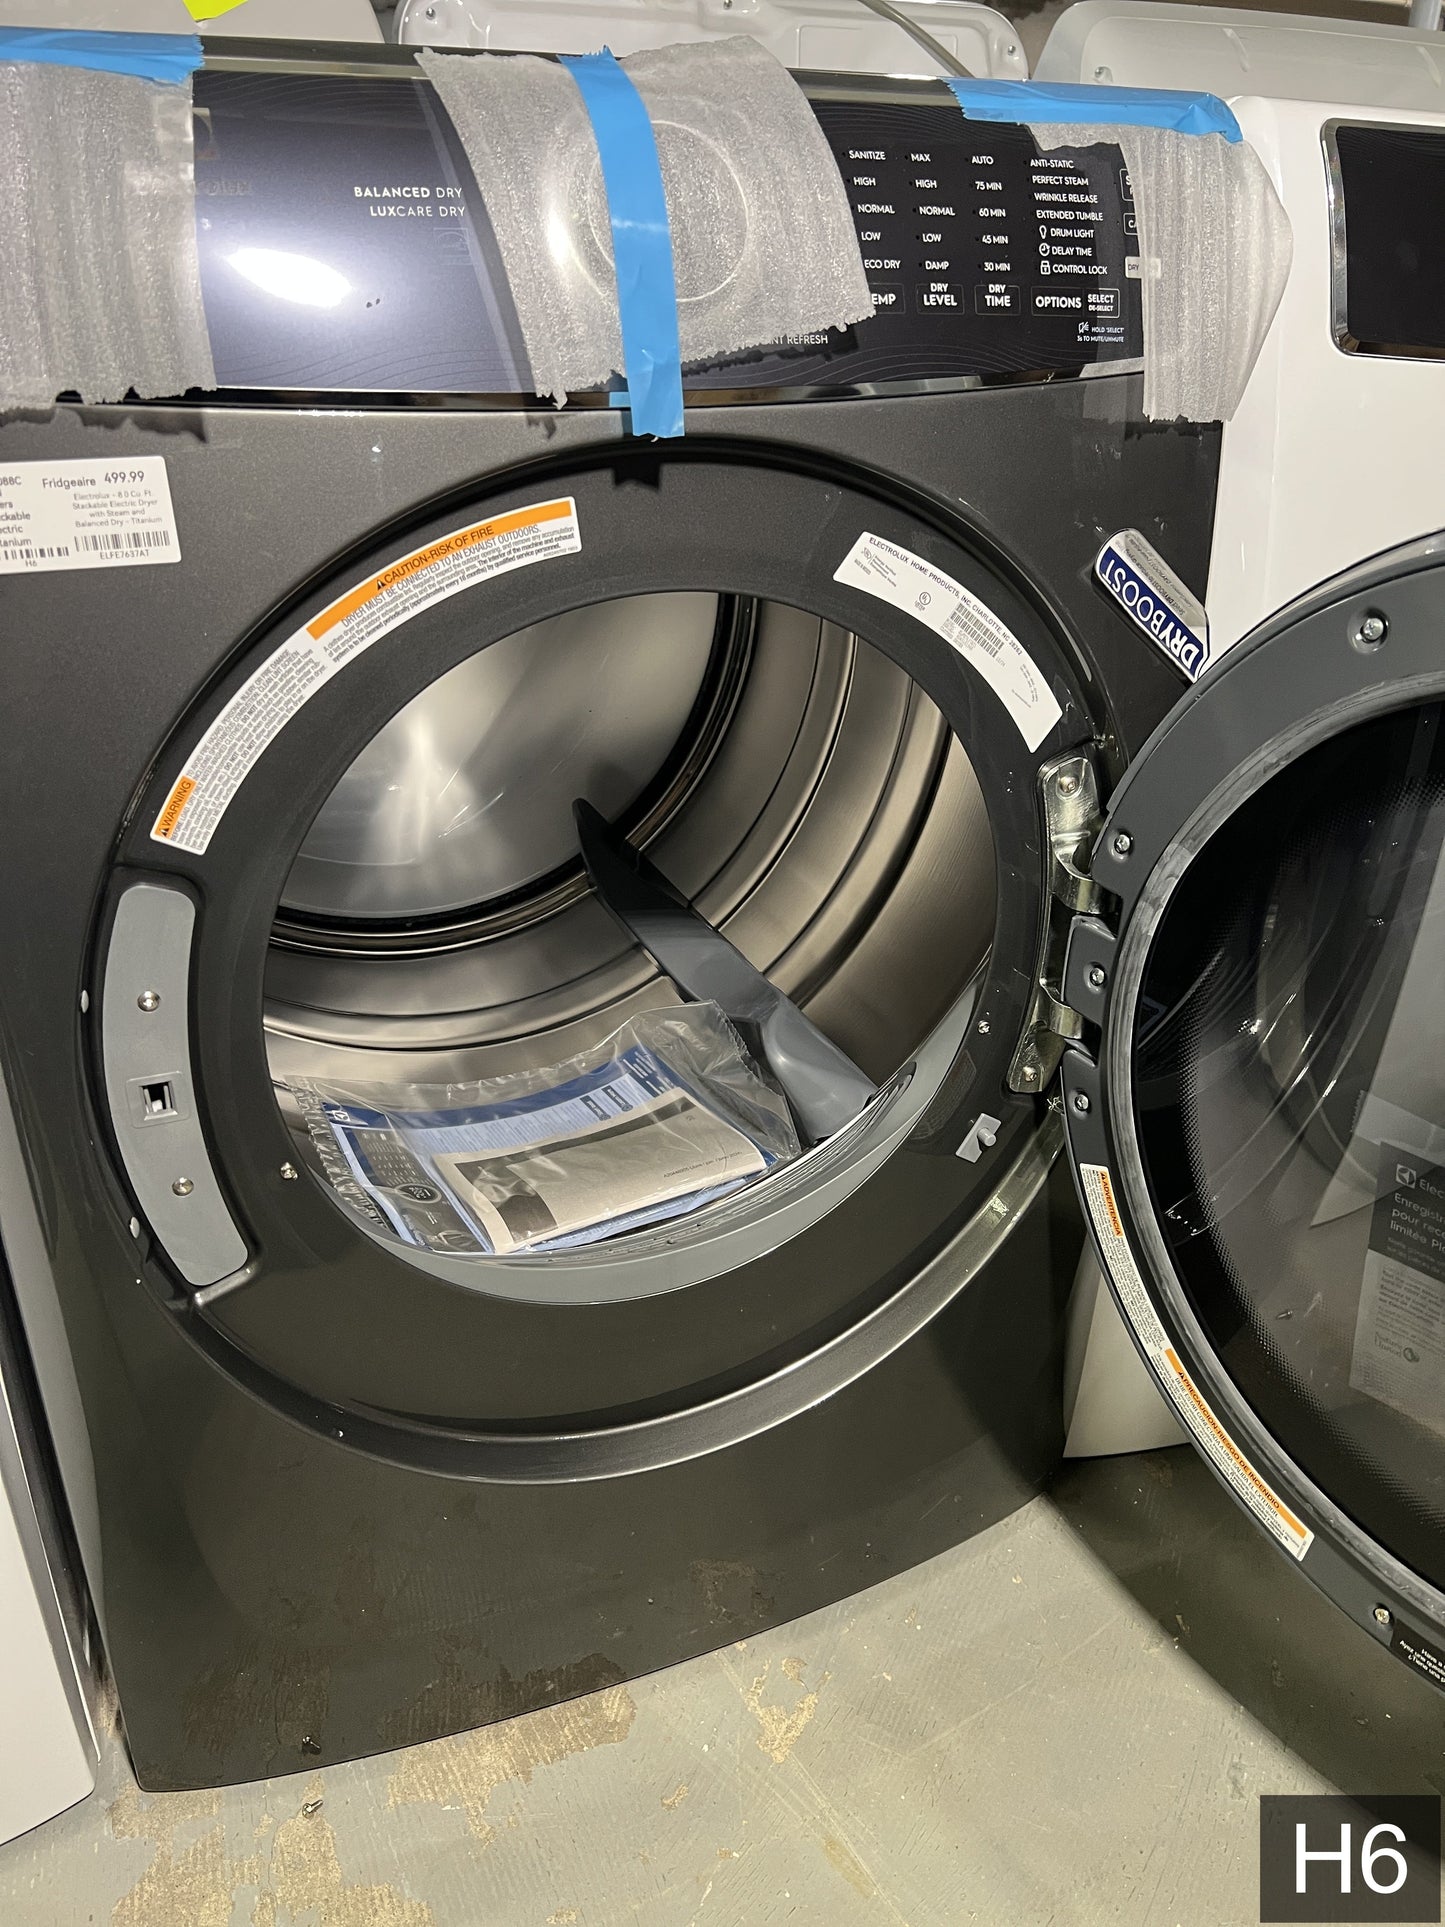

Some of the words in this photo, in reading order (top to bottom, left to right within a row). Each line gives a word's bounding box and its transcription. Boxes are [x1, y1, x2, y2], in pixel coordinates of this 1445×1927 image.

[848, 150, 886, 159] SANITIZE
[910, 153, 930, 161] MAX
[971, 155, 993, 164] AUTO
[1030, 159, 1074, 168] ANTI-STATIC
[853, 176, 876, 185] HIGH
[915, 179, 937, 188] HIGH
[1032, 175, 1062, 184] PERFECT
[1064, 176, 1088, 185] STEAM
[975, 181, 985, 189] 75
[986, 181, 1002, 190] MIN
[354, 186, 429, 197] BALANCED
[436, 187, 461, 197] DRY
[1034, 192, 1067, 201] WRINKLE
[1068, 194, 1097, 203] RELEASE
[370, 206, 432, 216] LUXCARE
[439, 206, 464, 216] DRY
[857, 204, 895, 213] NORMAL
[919, 205, 955, 215] NORMAL
[978, 207, 989, 216] 60
[990, 208, 1005, 216] MIN
[1036, 209, 1074, 219] EXTENDED
[1075, 211, 1103, 221] TUMBLE
[861, 231, 880, 240] LOW
[922, 233, 941, 242] LOW
[1050, 228, 1072, 237] DRUM
[1074, 229, 1094, 238] LIGHT
[982, 234, 991, 243] 45
[992, 235, 1008, 244] MIN
[1051, 246, 1074, 255] DELAY
[1075, 247, 1091, 255] TIME
[864, 259, 882, 268] ECO
[884, 260, 900, 268] DRY
[925, 260, 949, 269] DAMP
[983, 262, 993, 271] 30
[995, 262, 1010, 271] MIN
[1052, 264, 1087, 273] CONTROL
[1088, 265, 1107, 274] LOCK
[930, 282, 948, 292] DRY
[988, 284, 1005, 293] DRY
[871, 293, 895, 304] EMP
[923, 294, 957, 305] LEVEL
[984, 294, 1010, 306] TIME
[1035, 296, 1081, 308] OPTIONS
[1087, 293, 1114, 303] SELECT
[787, 334, 828, 345] REFRESH
[42, 477, 96, 489] Fridgeaire
[104, 469, 144, 484] 499.99
[73, 491, 109, 501] Electrolux
[72, 501, 108, 510] Stackable
[110, 499, 136, 508] Electric
[138, 497, 157, 507] Dryer
[106, 509, 129, 517] Steam
[75, 518, 108, 528] Balanced
[111, 518, 123, 527] Dry
[131, 516, 162, 524] Titanium
[521, 539, 543, 551] machine
[543, 536, 554, 544] and
[99, 548, 149, 560] ELFE7637AT
[383, 541, 454, 584] CAUTION-RISK
[453, 533, 470, 548] OF
[470, 525, 494, 540] FIRE
[340, 605, 366, 627] DRYER
[364, 592, 386, 611] MUST
[385, 585, 397, 597] BE
[395, 561, 441, 591] CONNECTED
[439, 556, 452, 567] TO
[451, 551, 463, 562] AN
[463, 537, 497, 557] EXHAUST
[497, 523, 541, 544] OUTDOORS.
[868, 536, 909, 563] ELECTROLUX
[910, 560, 929, 575] HOME
[928, 571, 961, 598] PRODUCTS,
[1001, 632, 1010, 642] NC
[1098, 558, 1205, 670] DRYBOOST
[161, 779, 191, 828] WARNING
[1101, 1180, 1121, 1235] ADVERTENCIA
[1390, 1208, 1418, 1225] pour
[1238, 1459, 1249, 1472] DE
[1247, 1471, 1280, 1509] INCENDIO
